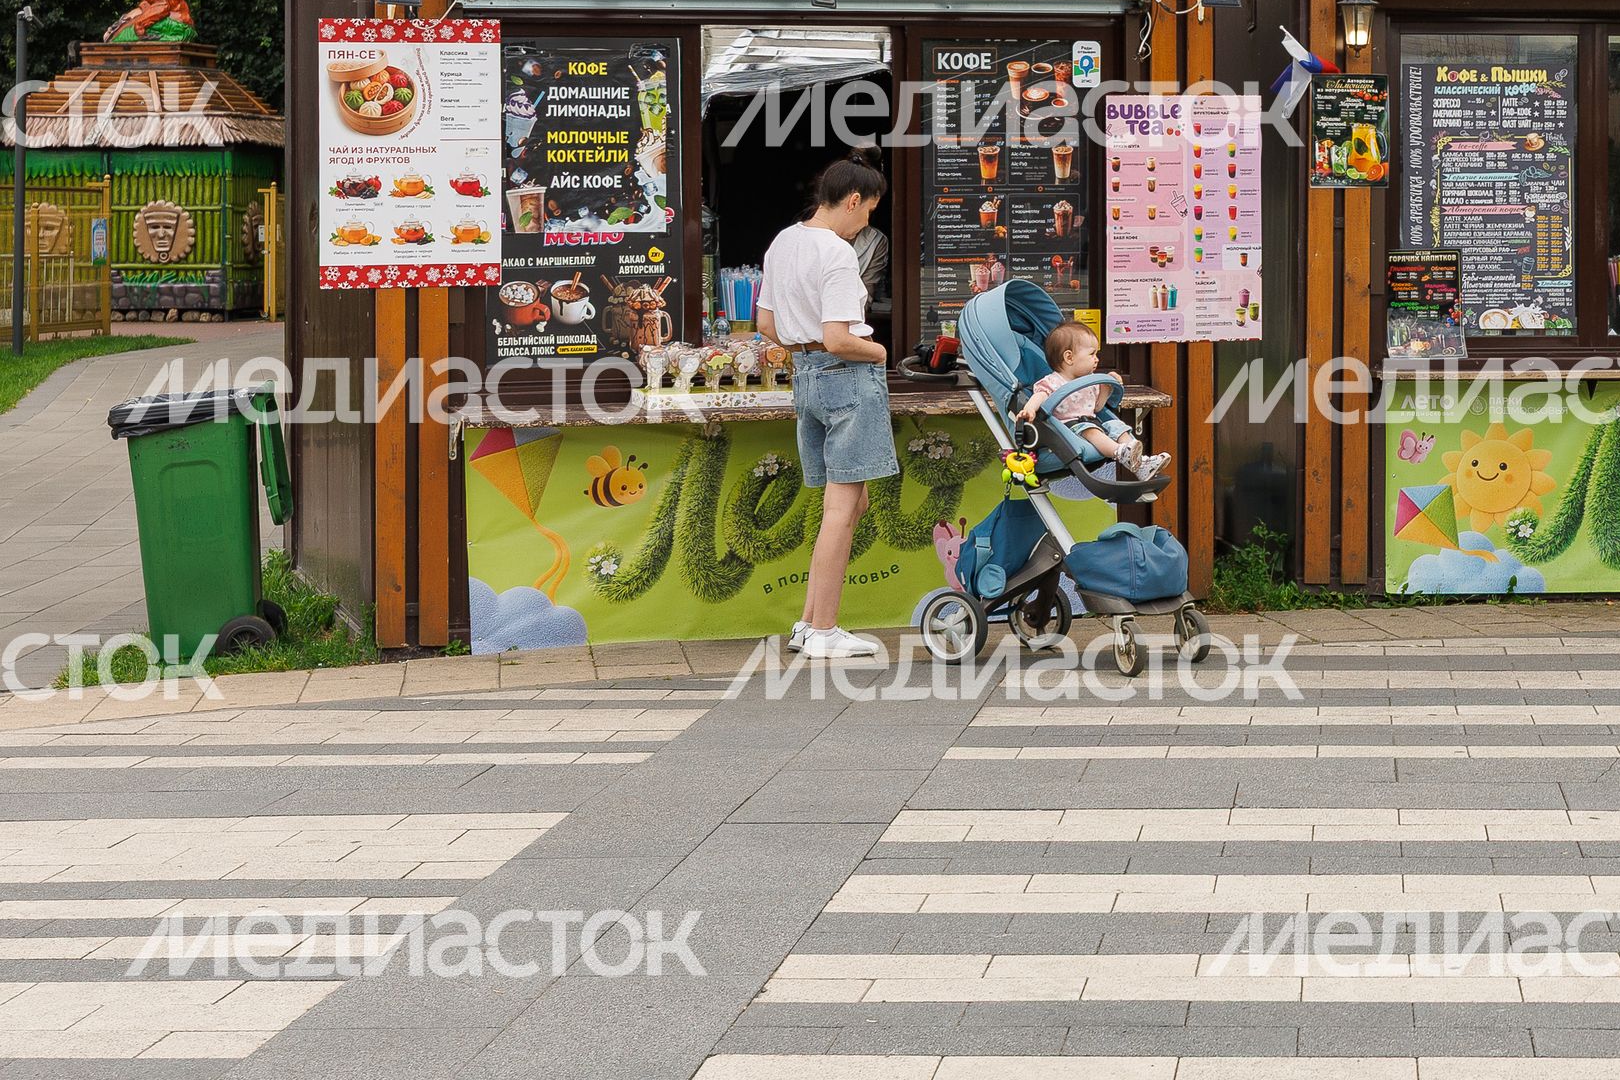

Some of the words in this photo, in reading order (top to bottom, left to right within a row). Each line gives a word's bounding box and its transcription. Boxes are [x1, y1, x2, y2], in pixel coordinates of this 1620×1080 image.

[328, 50, 376, 59] ПЯН-СЕ
[937, 52, 991, 70] КОФЕ
[569, 62, 607, 75] КОФЕ
[1481, 73, 1488, 82] &
[547, 87, 629, 100] ДОМАШНИЕ
[1434, 84, 1501, 94] КЛАССИЧЕСКИЙ
[1433, 98, 1460, 108] ЭСПРЕССО
[1502, 98, 1518, 106] ЛАТТЕ
[546, 105, 631, 118] ЛИМОНАДЫ
[1433, 110, 1462, 118] АМЕРИКАНО
[1502, 108, 1531, 116] РАФ-КОФЕ
[1433, 120, 1461, 128] КАПУЧИНО
[547, 131, 628, 144] МОЛОЧНЫЕ
[547, 147, 628, 162] КОКТЕЙЛИ
[1410, 148, 1422, 168] 100%
[551, 172, 580, 188] АЙС
[583, 175, 622, 188] КОФЕ
[1411, 226, 1422, 245] 100%
[501, 257, 525, 267] АКАО
[528, 257, 533, 266] С
[536, 256, 596, 266] МАРШМЕЛЛОУ
[619, 255, 645, 263] КАКАО
[619, 263, 664, 274] АВТОРСКИЙ
[498, 335, 555, 346] БЕЛЬГИЙСКИЙ
[557, 335, 597, 345] ШОКОЛАД
[498, 347, 530, 357] КЛАССА
[531, 346, 555, 355] ЛЮКС
[763, 584, 773, 594] в
[778, 564, 900, 587] подковье
